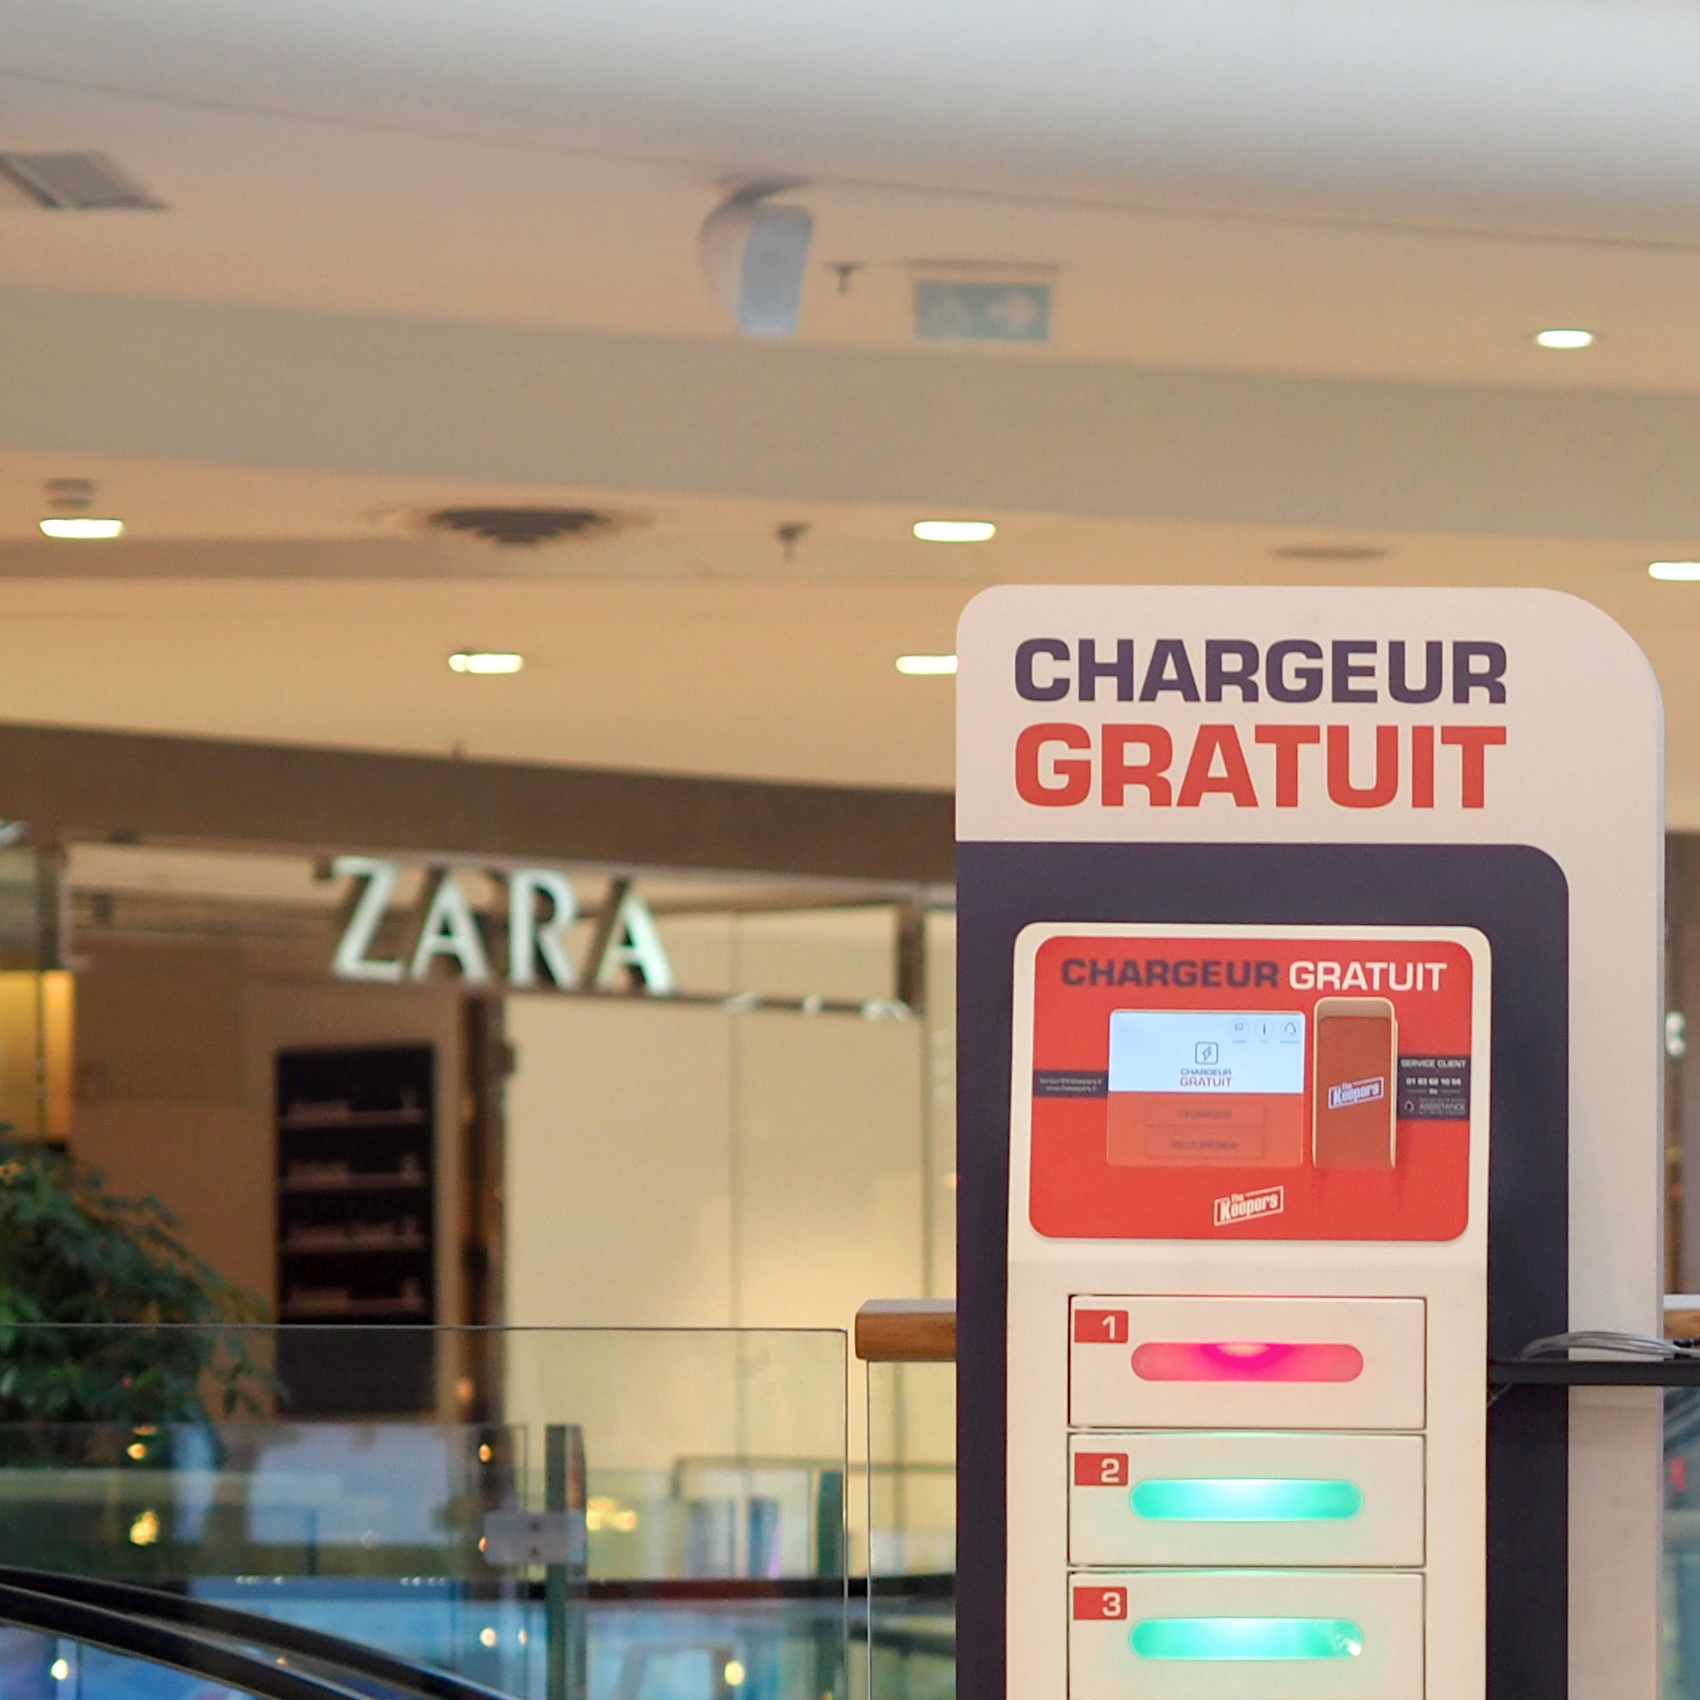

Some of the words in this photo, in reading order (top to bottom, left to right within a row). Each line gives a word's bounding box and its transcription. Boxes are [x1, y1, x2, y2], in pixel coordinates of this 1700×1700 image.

[1014, 637, 1508, 705] CHARGEUR
[1014, 721, 1508, 809] GRATUIT
[332, 855, 675, 995] ZARA
[1061, 958, 1280, 988] CHARGEUR
[1288, 960, 1448, 992] GRATUIT
[1180, 1068, 1233, 1076] CHARGEUR
[1437, 1059, 1466, 1069] CLIENT
[1180, 1078, 1233, 1088] GRATUIT
[1332, 1081, 1381, 1106] Keepers
[1220, 1191, 1279, 1223] Keepers
[1101, 1315, 1117, 1339] 1
[1100, 1457, 1120, 1483] 2
[1101, 1591, 1122, 1616] 3
